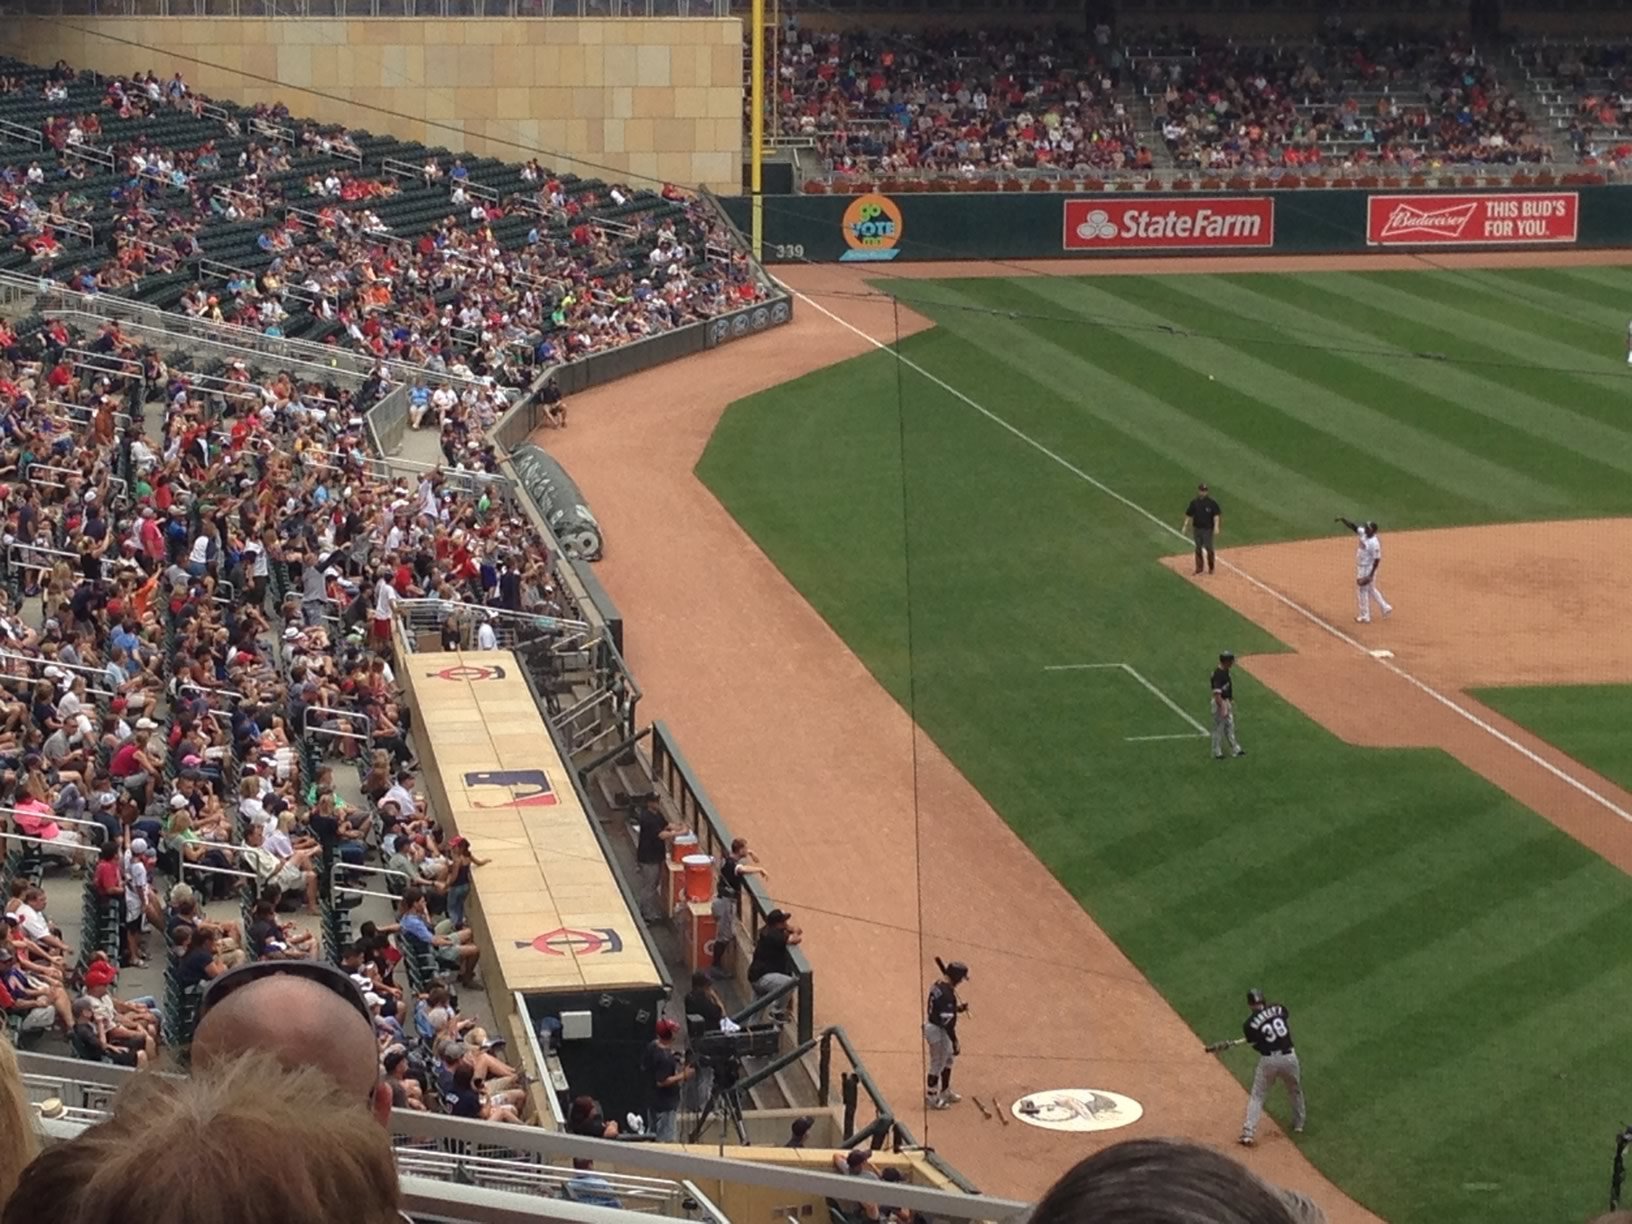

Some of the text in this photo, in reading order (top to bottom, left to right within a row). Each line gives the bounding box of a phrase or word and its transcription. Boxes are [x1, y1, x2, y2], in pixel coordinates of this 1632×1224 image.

[1485, 200, 1566, 217] THIS BUD'S
[1390, 211, 1465, 228] Budweiser
[1484, 219, 1549, 236] FOR YOU.
[849, 221, 895, 237] VOTE
[776, 244, 804, 259] 339
[1261, 1017, 1288, 1043] 38
